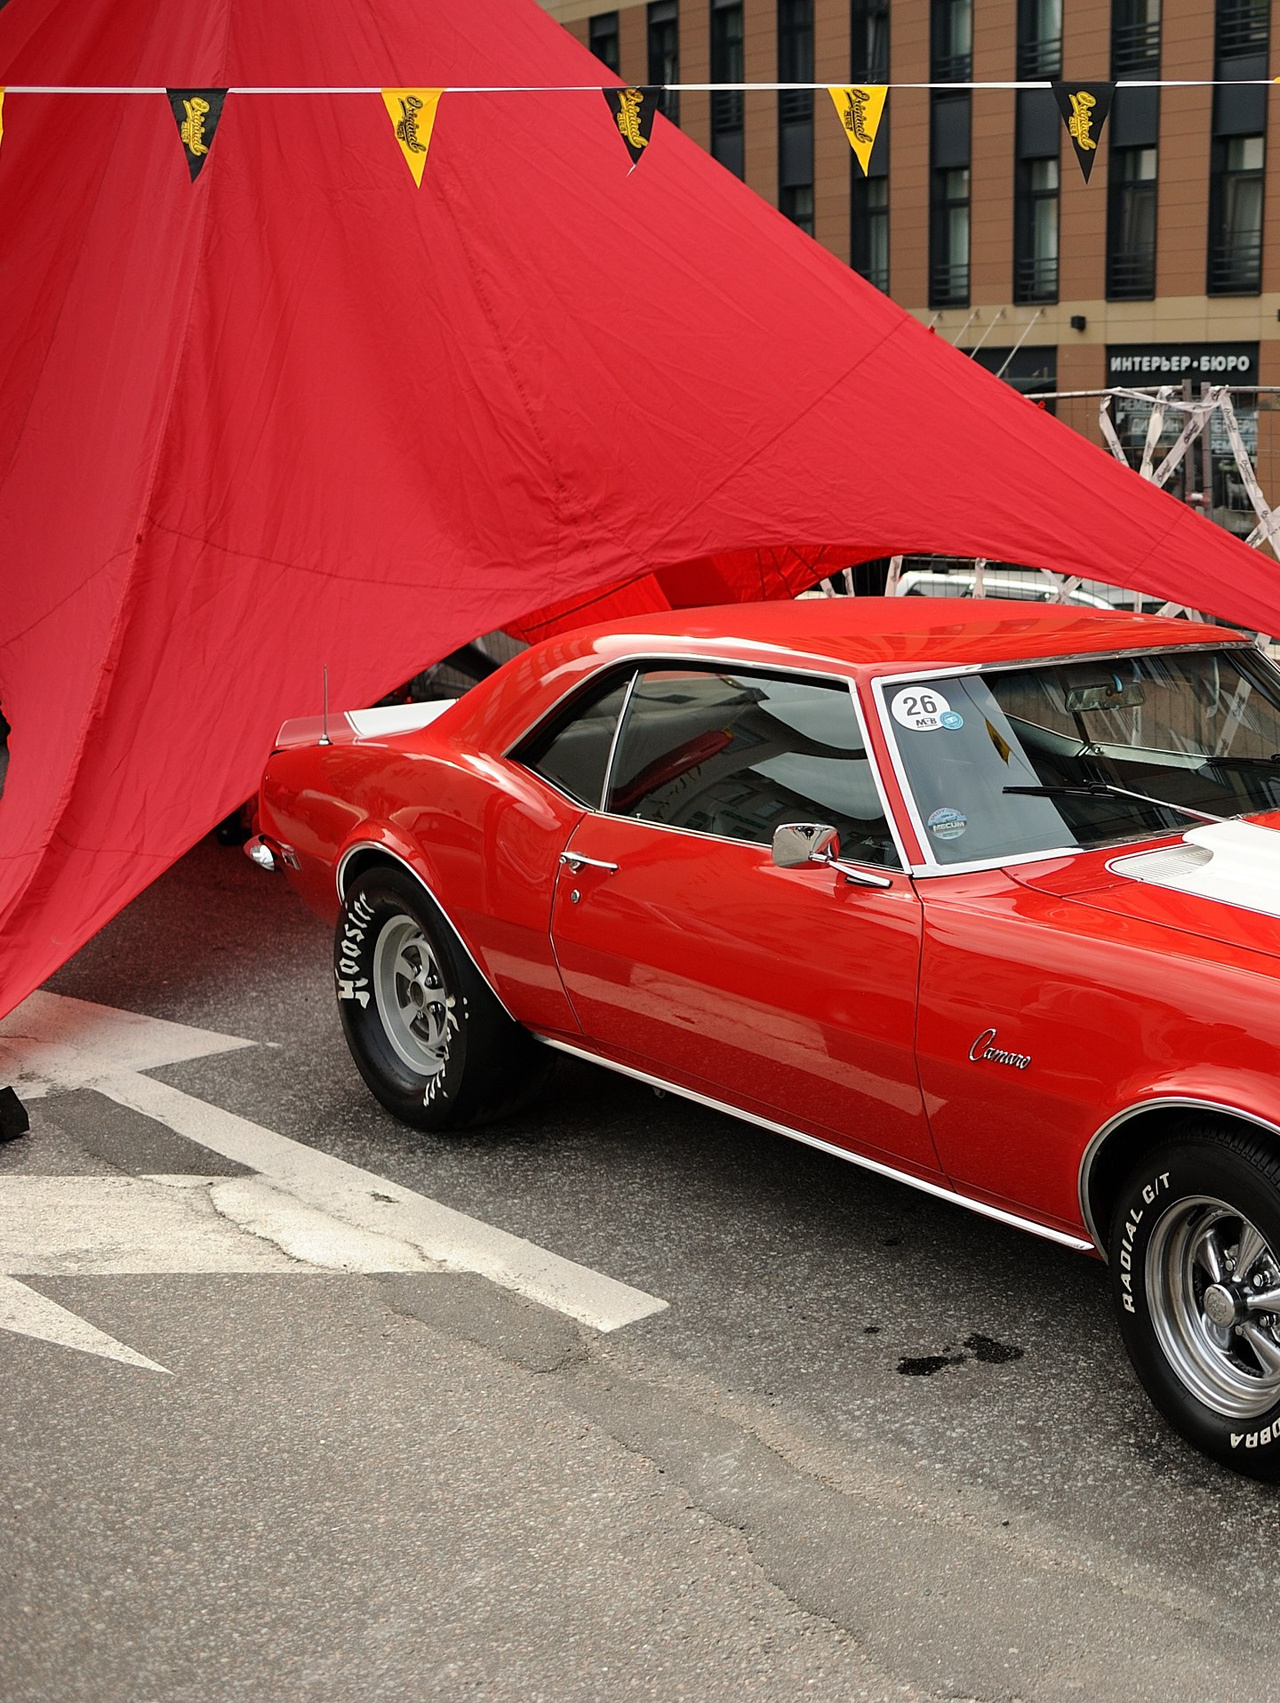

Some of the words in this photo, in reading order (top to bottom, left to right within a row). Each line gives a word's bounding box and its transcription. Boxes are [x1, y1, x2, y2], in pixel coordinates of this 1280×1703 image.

[182, 97, 211, 156] Original
[398, 95, 428, 154] Original
[616, 88, 650, 149] Original
[842, 88, 874, 144] Original
[1068, 91, 1098, 151] Original
[903, 695, 938, 717] 26
[336, 889, 376, 1010] Hoosier
[969, 1028, 1032, 1069] Camaro
[1120, 1208, 1144, 1314] RADIAL
[1141, 1171, 1171, 1205] G/T
